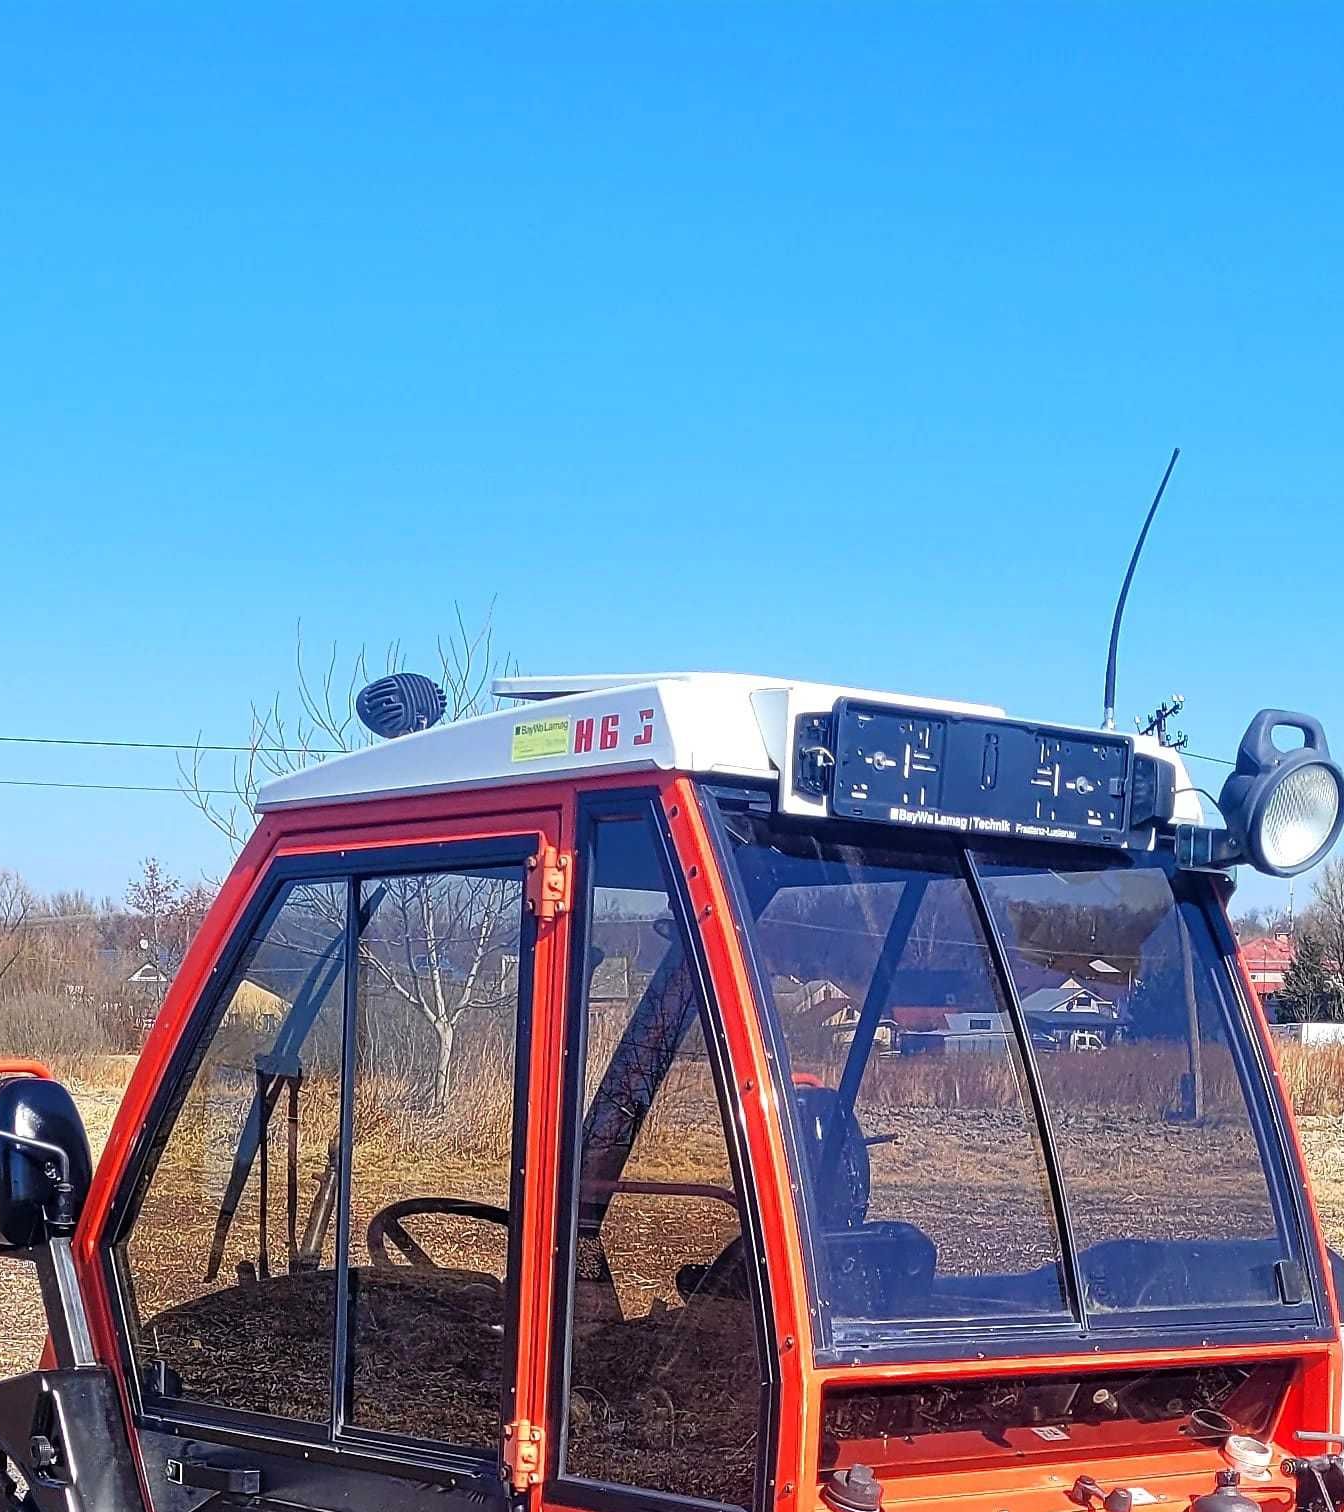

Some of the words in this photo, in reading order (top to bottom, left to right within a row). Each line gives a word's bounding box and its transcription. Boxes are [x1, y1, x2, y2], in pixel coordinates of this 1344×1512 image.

[574, 714, 619, 753] H6
[899, 808, 933, 825] BayWa
[935, 812, 968, 830] Lamag
[973, 816, 1011, 832] Technik
